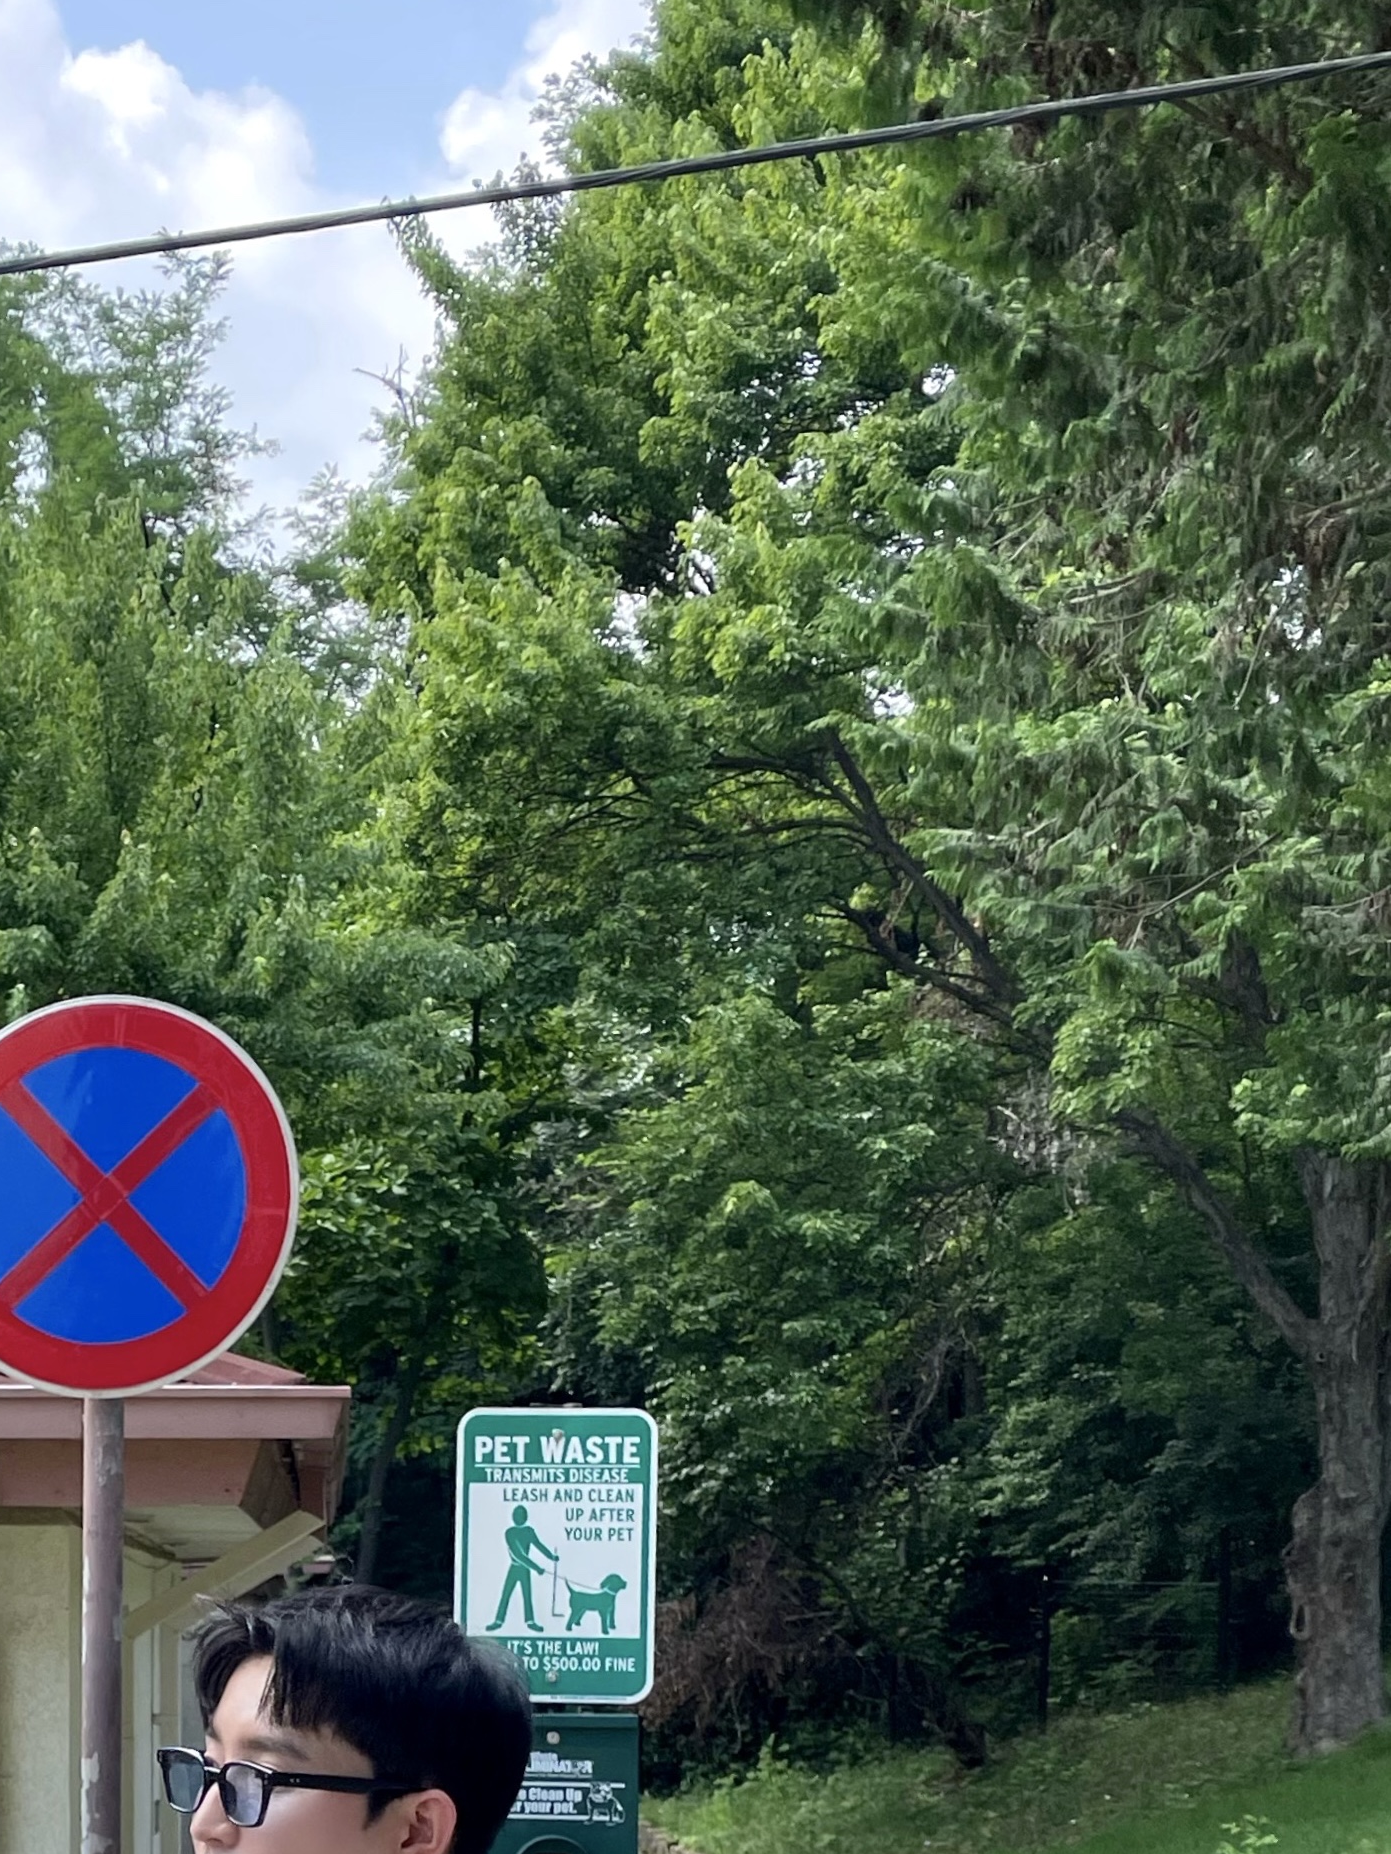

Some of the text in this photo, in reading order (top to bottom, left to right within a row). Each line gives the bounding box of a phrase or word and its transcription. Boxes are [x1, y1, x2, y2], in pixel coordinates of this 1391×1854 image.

[474, 1435, 641, 1464] PET WASTE
[485, 1468, 629, 1483] TRANSMITS DISEASE
[503, 1488, 634, 1503] LEASH AND CLEAN
[565, 1507, 635, 1522] UP AFTER
[564, 1527, 634, 1542] YOUR PET
[536, 1640, 563, 1655] THE
[543, 1656, 601, 1672] $500.00
[605, 1657, 636, 1672] FINE
[528, 1787, 564, 1802] Clean
[565, 1788, 583, 1803] Up
[523, 1801, 552, 1814] your
[553, 1802, 578, 1815] pet.
